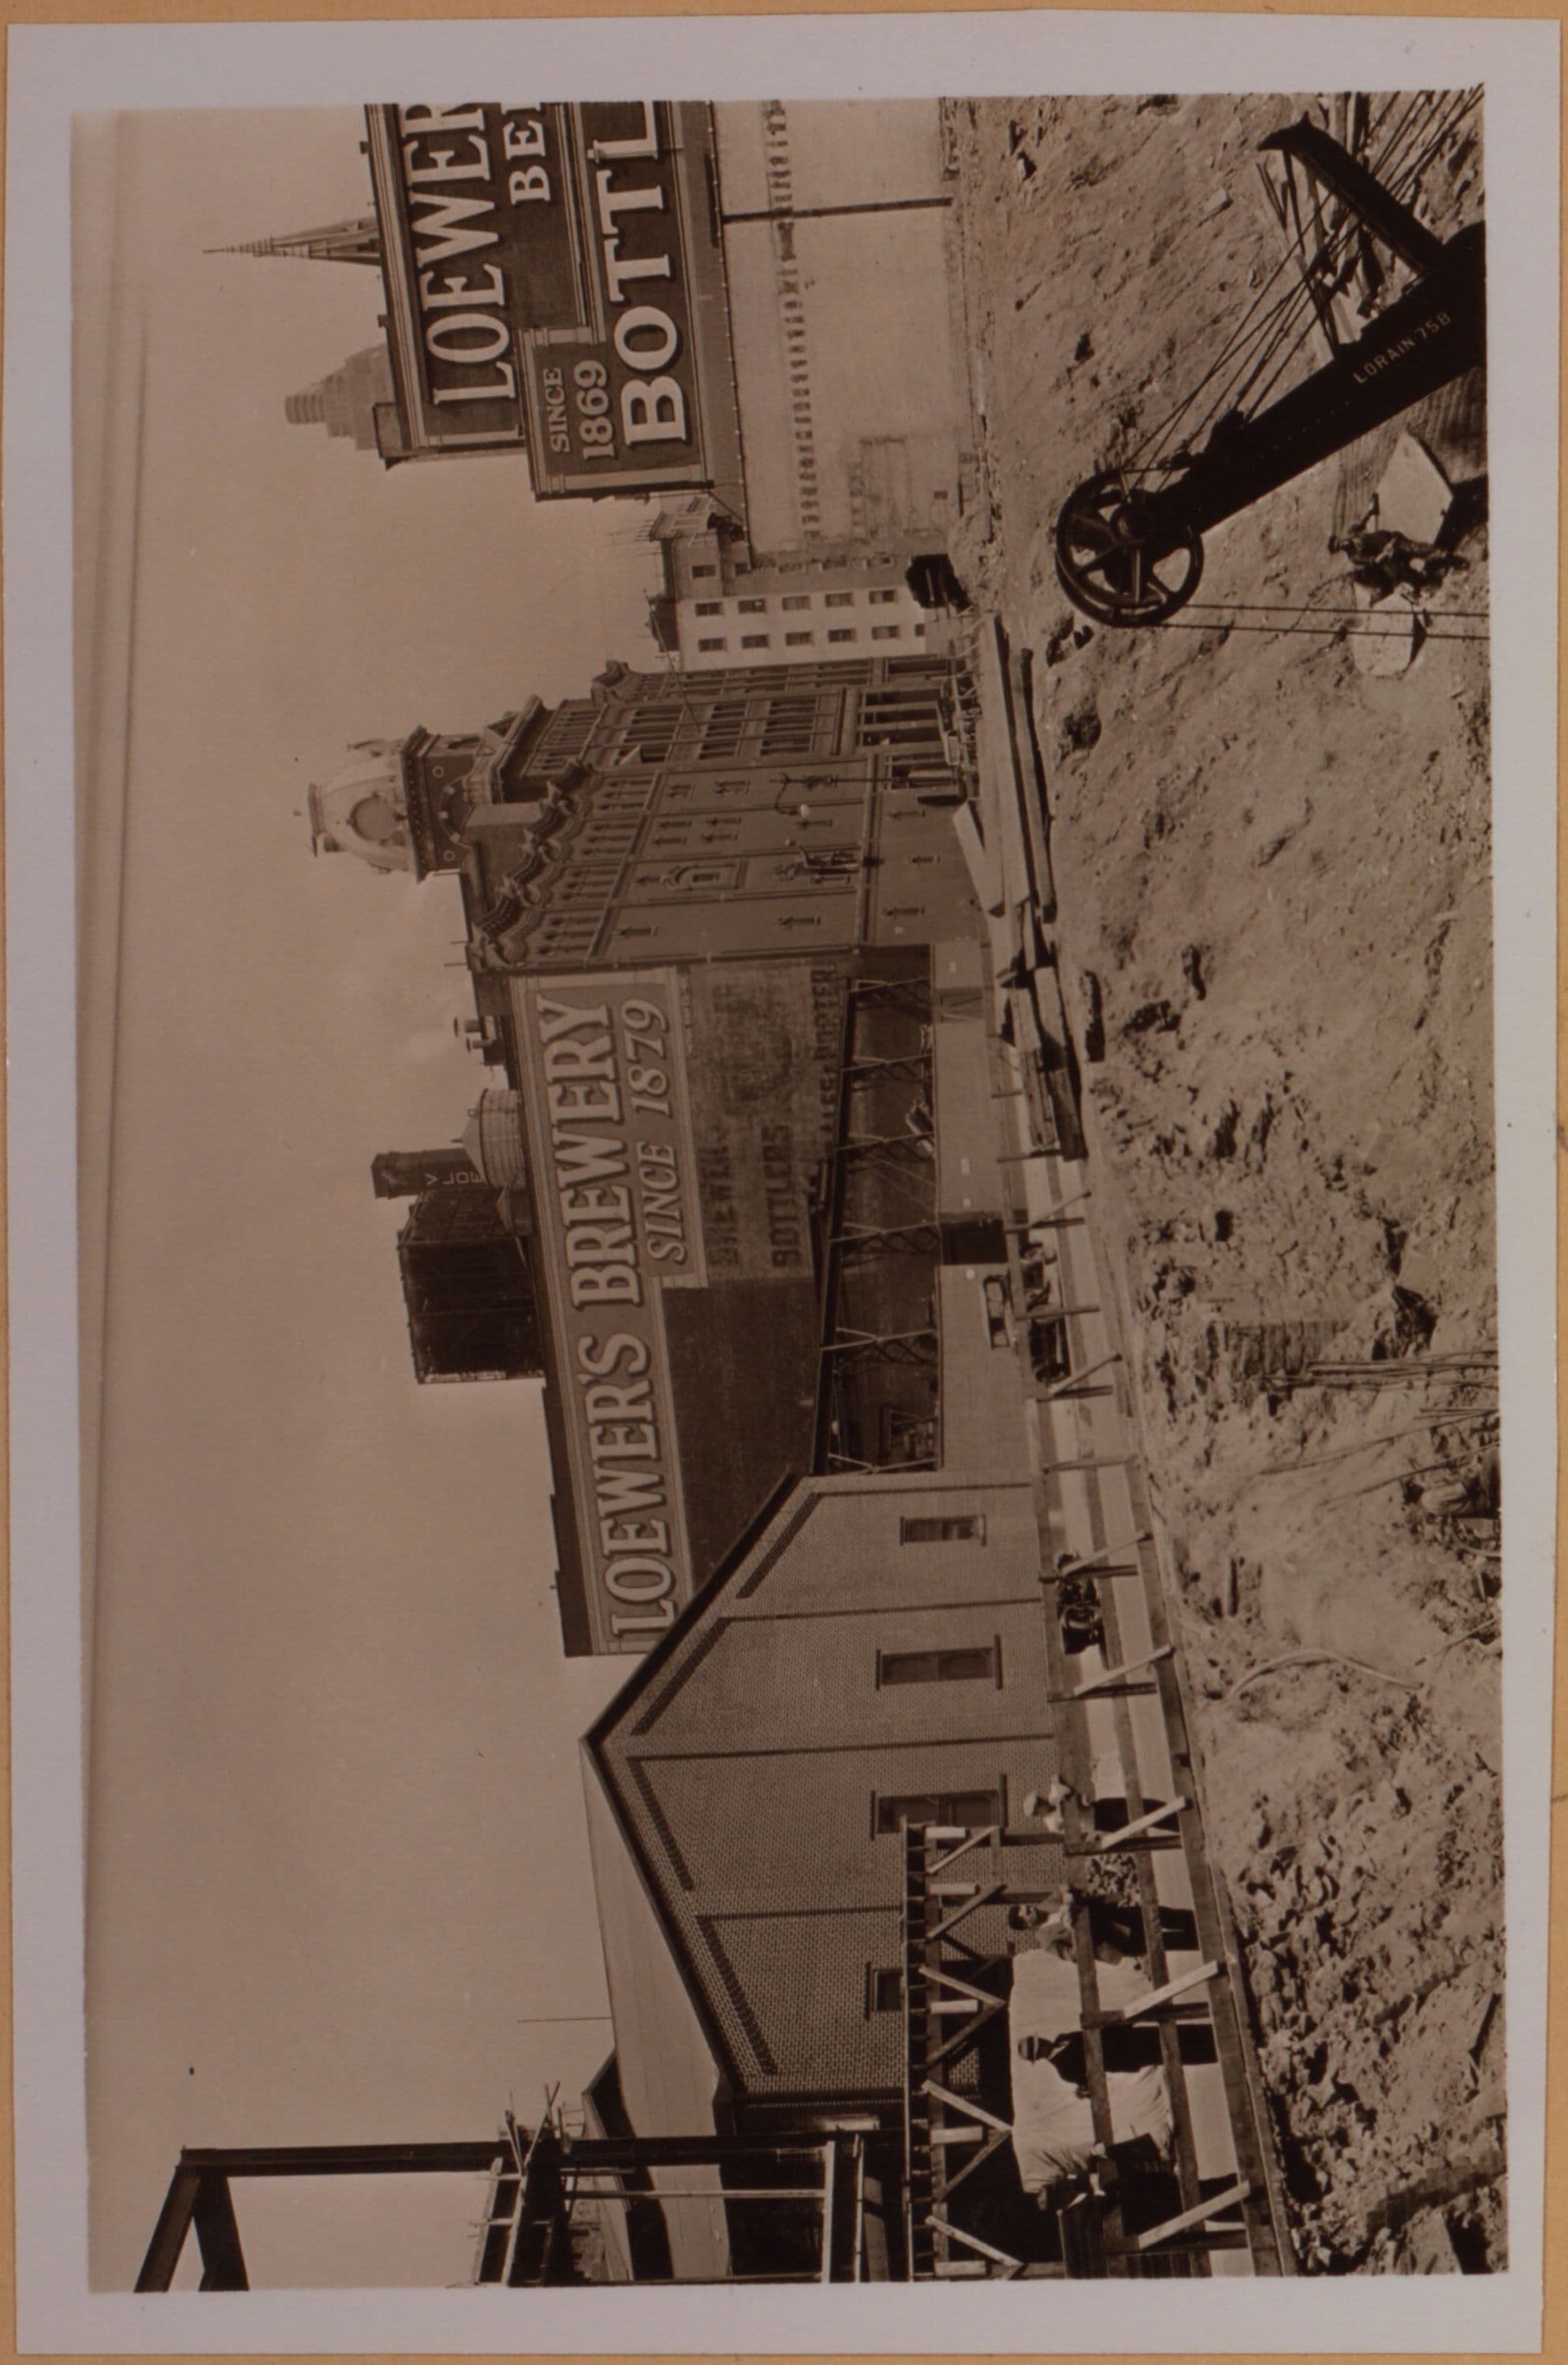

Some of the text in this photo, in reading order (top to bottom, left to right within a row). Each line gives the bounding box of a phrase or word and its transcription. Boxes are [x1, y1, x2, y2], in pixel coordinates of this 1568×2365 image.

[591, 100, 689, 447] BOTTL
[542, 367, 571, 453] SINCE
[574, 359, 616, 460] 1869
[620, 997, 687, 1265] SINCE 1879
[761, 1124, 802, 1267] BOTTLERS
[534, 993, 679, 1638] LOEWER'S BREWERY
